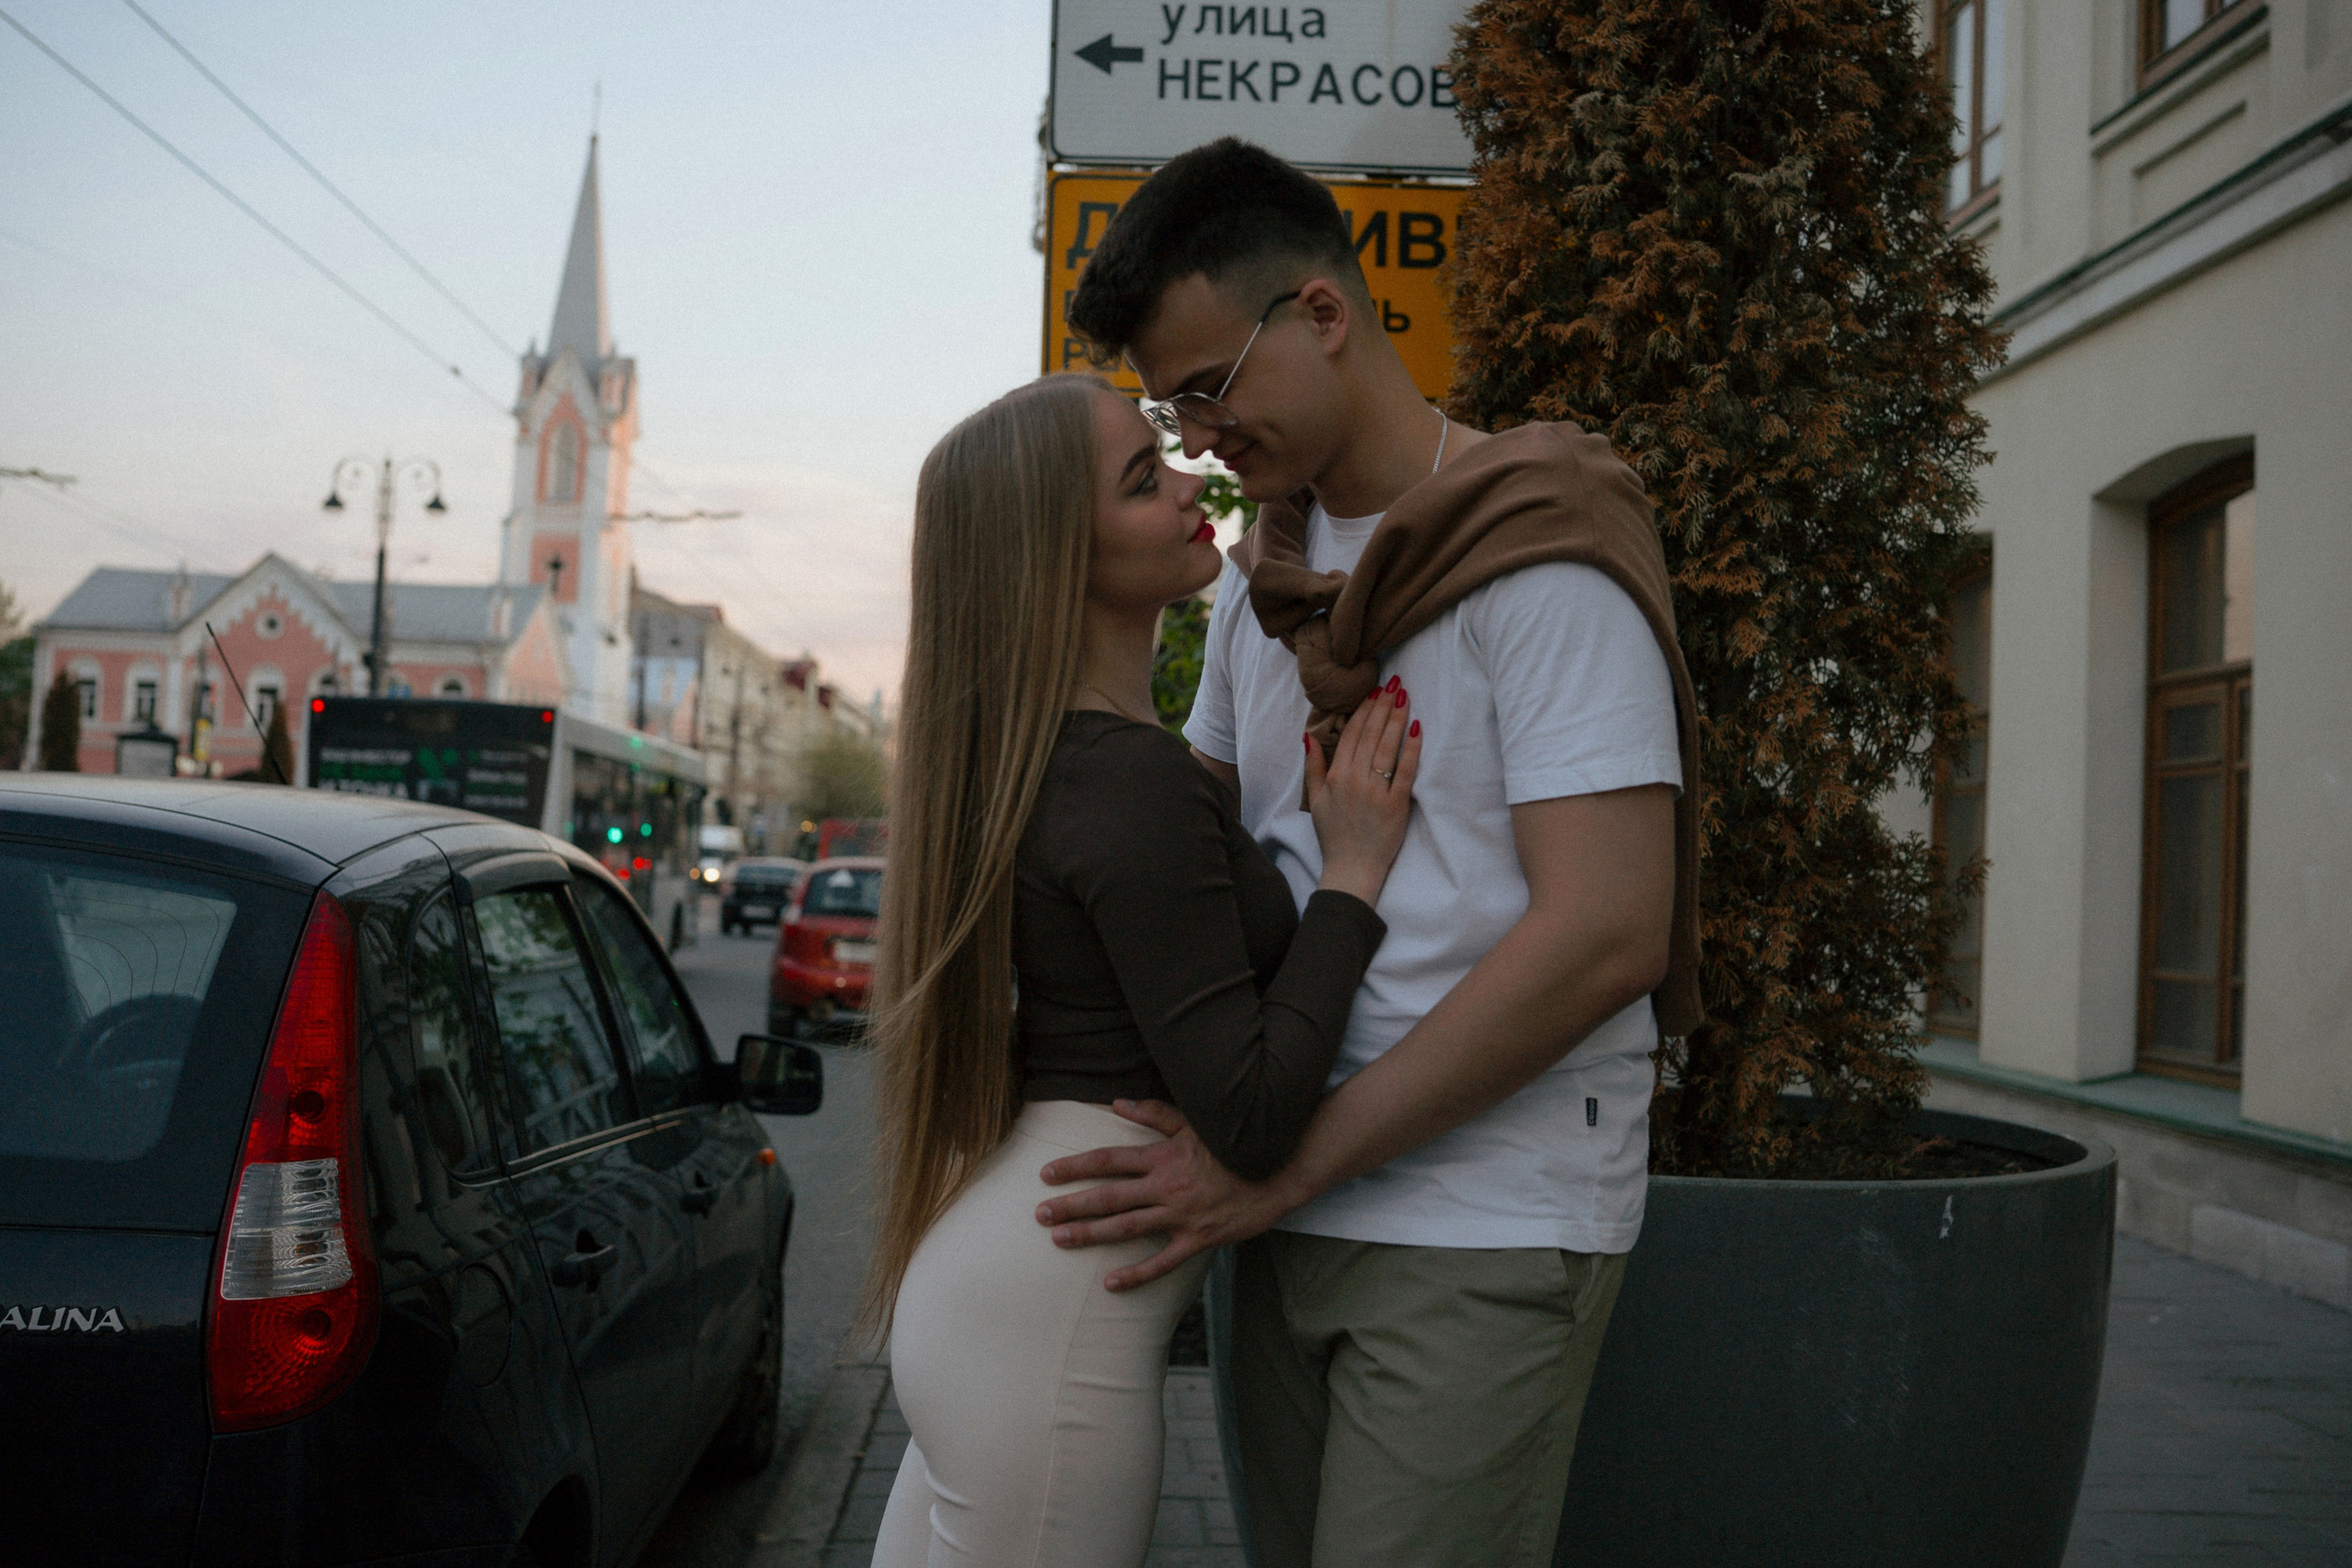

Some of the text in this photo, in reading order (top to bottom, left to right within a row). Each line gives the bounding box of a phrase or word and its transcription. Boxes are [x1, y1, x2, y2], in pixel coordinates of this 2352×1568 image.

[1161, 3, 1327, 44] улица
[1158, 58, 1459, 108] НЕКРАСОВ
[0, 1305, 124, 1332] ALINA
